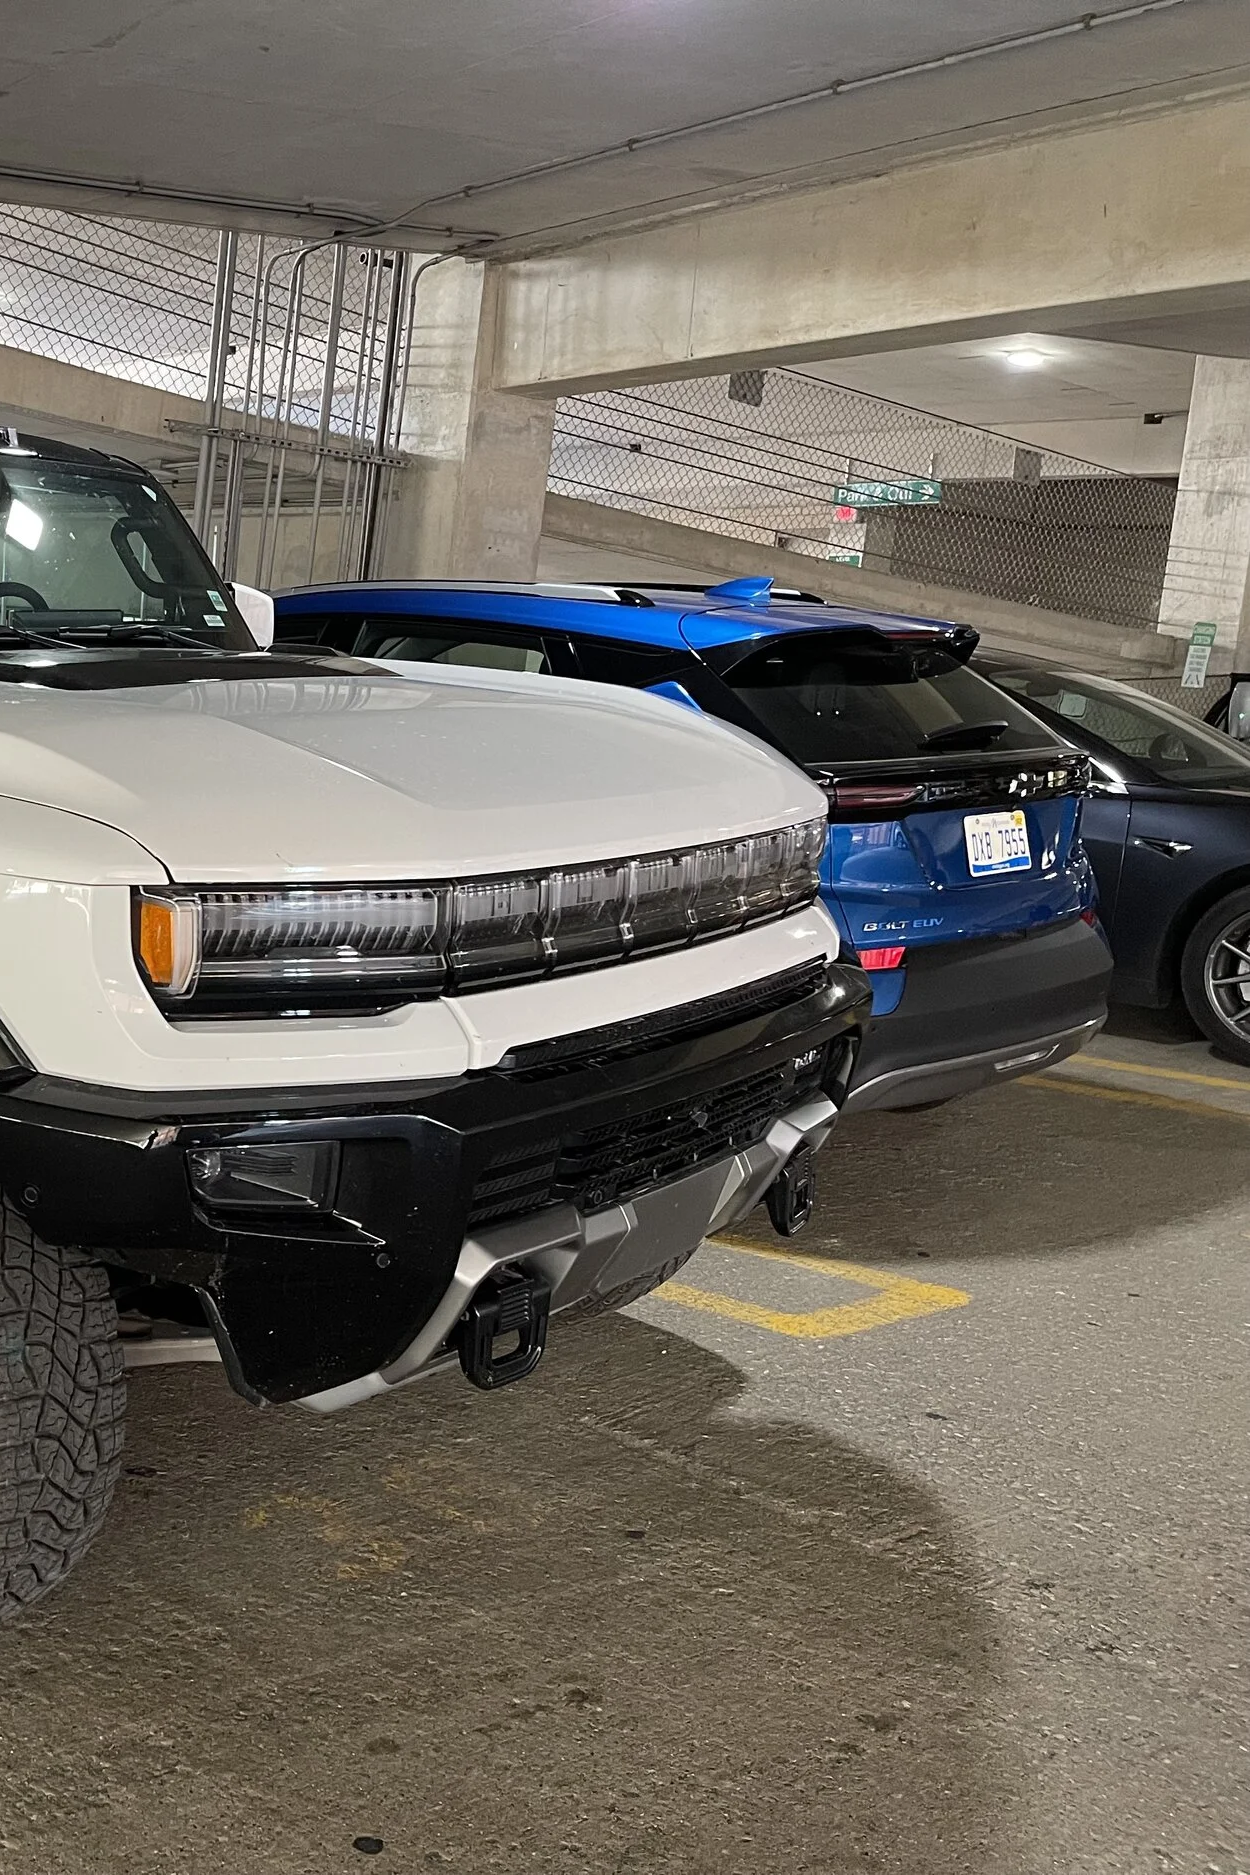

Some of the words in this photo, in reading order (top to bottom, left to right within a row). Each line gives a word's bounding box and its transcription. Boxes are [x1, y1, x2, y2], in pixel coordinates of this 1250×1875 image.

[972, 831, 993, 861] DXB
[997, 828, 1026, 858] 7955
[912, 917, 944, 928] EUV
